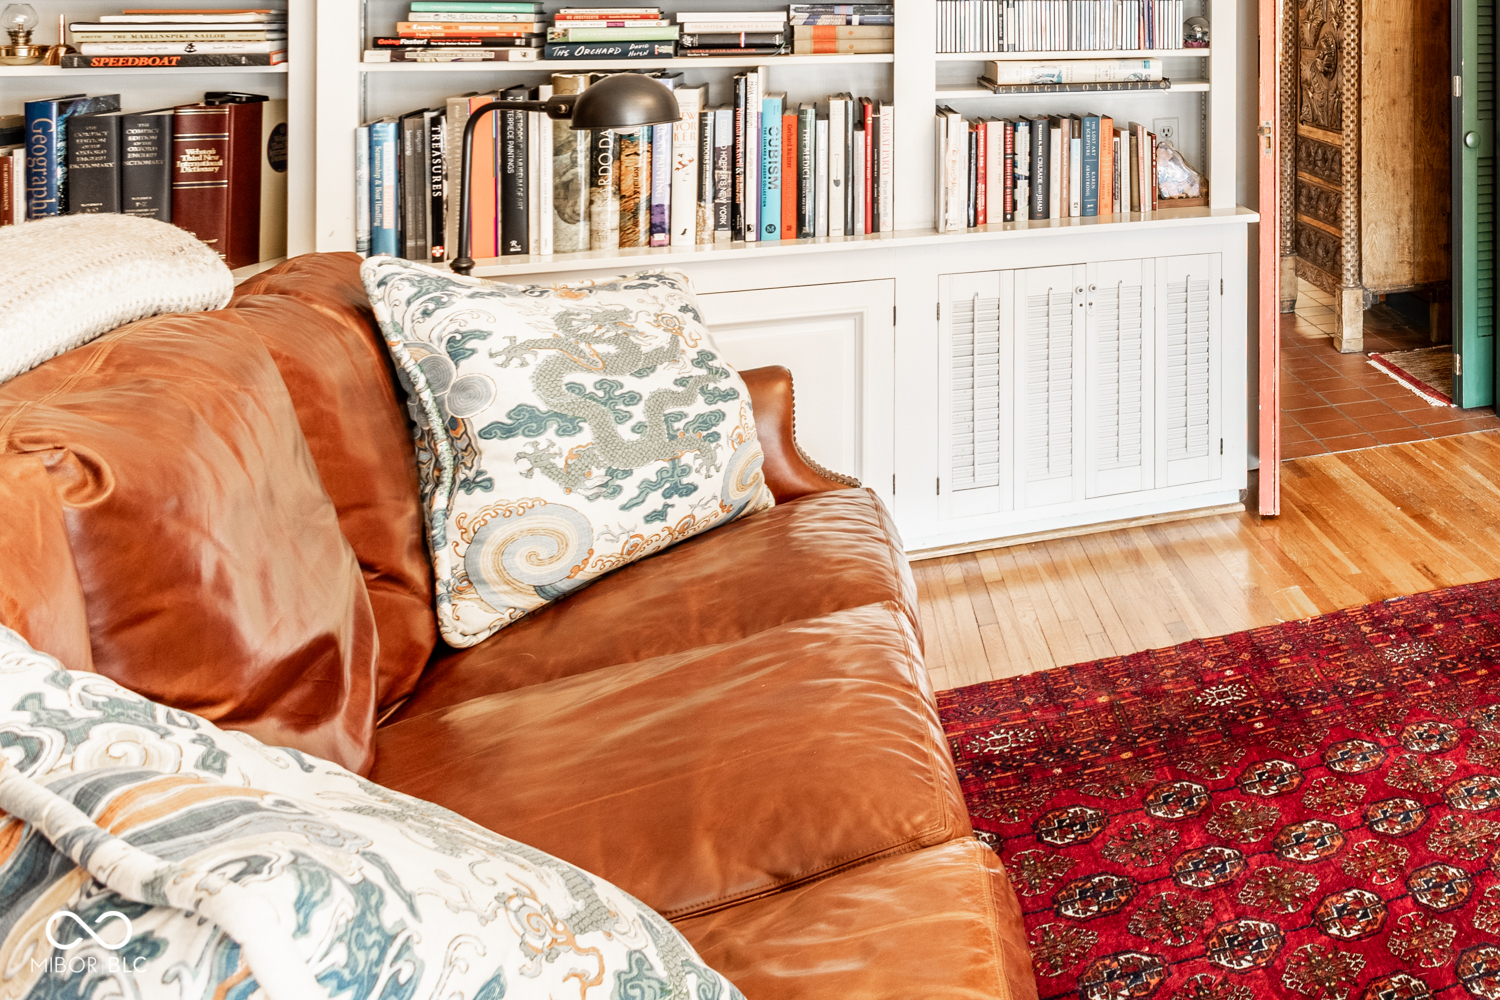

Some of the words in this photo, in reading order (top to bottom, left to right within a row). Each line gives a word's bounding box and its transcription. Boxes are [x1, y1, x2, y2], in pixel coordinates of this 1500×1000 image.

[412, 24, 444, 32] Esquire
[90, 56, 181, 67] SPEEDBOAT
[574, 45, 622, 57] ORCHARD
[1000, 84, 1070, 93] GEORGIA
[1082, 82, 1154, 91] O'KEEFFE
[674, 122, 697, 131] YOR
[674, 132, 696, 142] KER
[882, 118, 890, 148] GREAT
[598, 128, 614, 149] DA
[176, 160, 224, 168] International
[180, 154, 202, 162] Third
[203, 154, 220, 162] New
[373, 146, 382, 178] Seamanship
[431, 124, 443, 197] TREASURES
[506, 140, 514, 174] PAINTINGS
[768, 126, 780, 190] CUBISM
[882, 150, 890, 176] PARTY
[27, 117, 56, 220] Geographi
[180, 166, 220, 174] Dictionary
[656, 153, 664, 198] PAINTING
[720, 150, 728, 187] HOPPER'S
[373, 200, 382, 227] Handling
[719, 204, 727, 225] YORK
